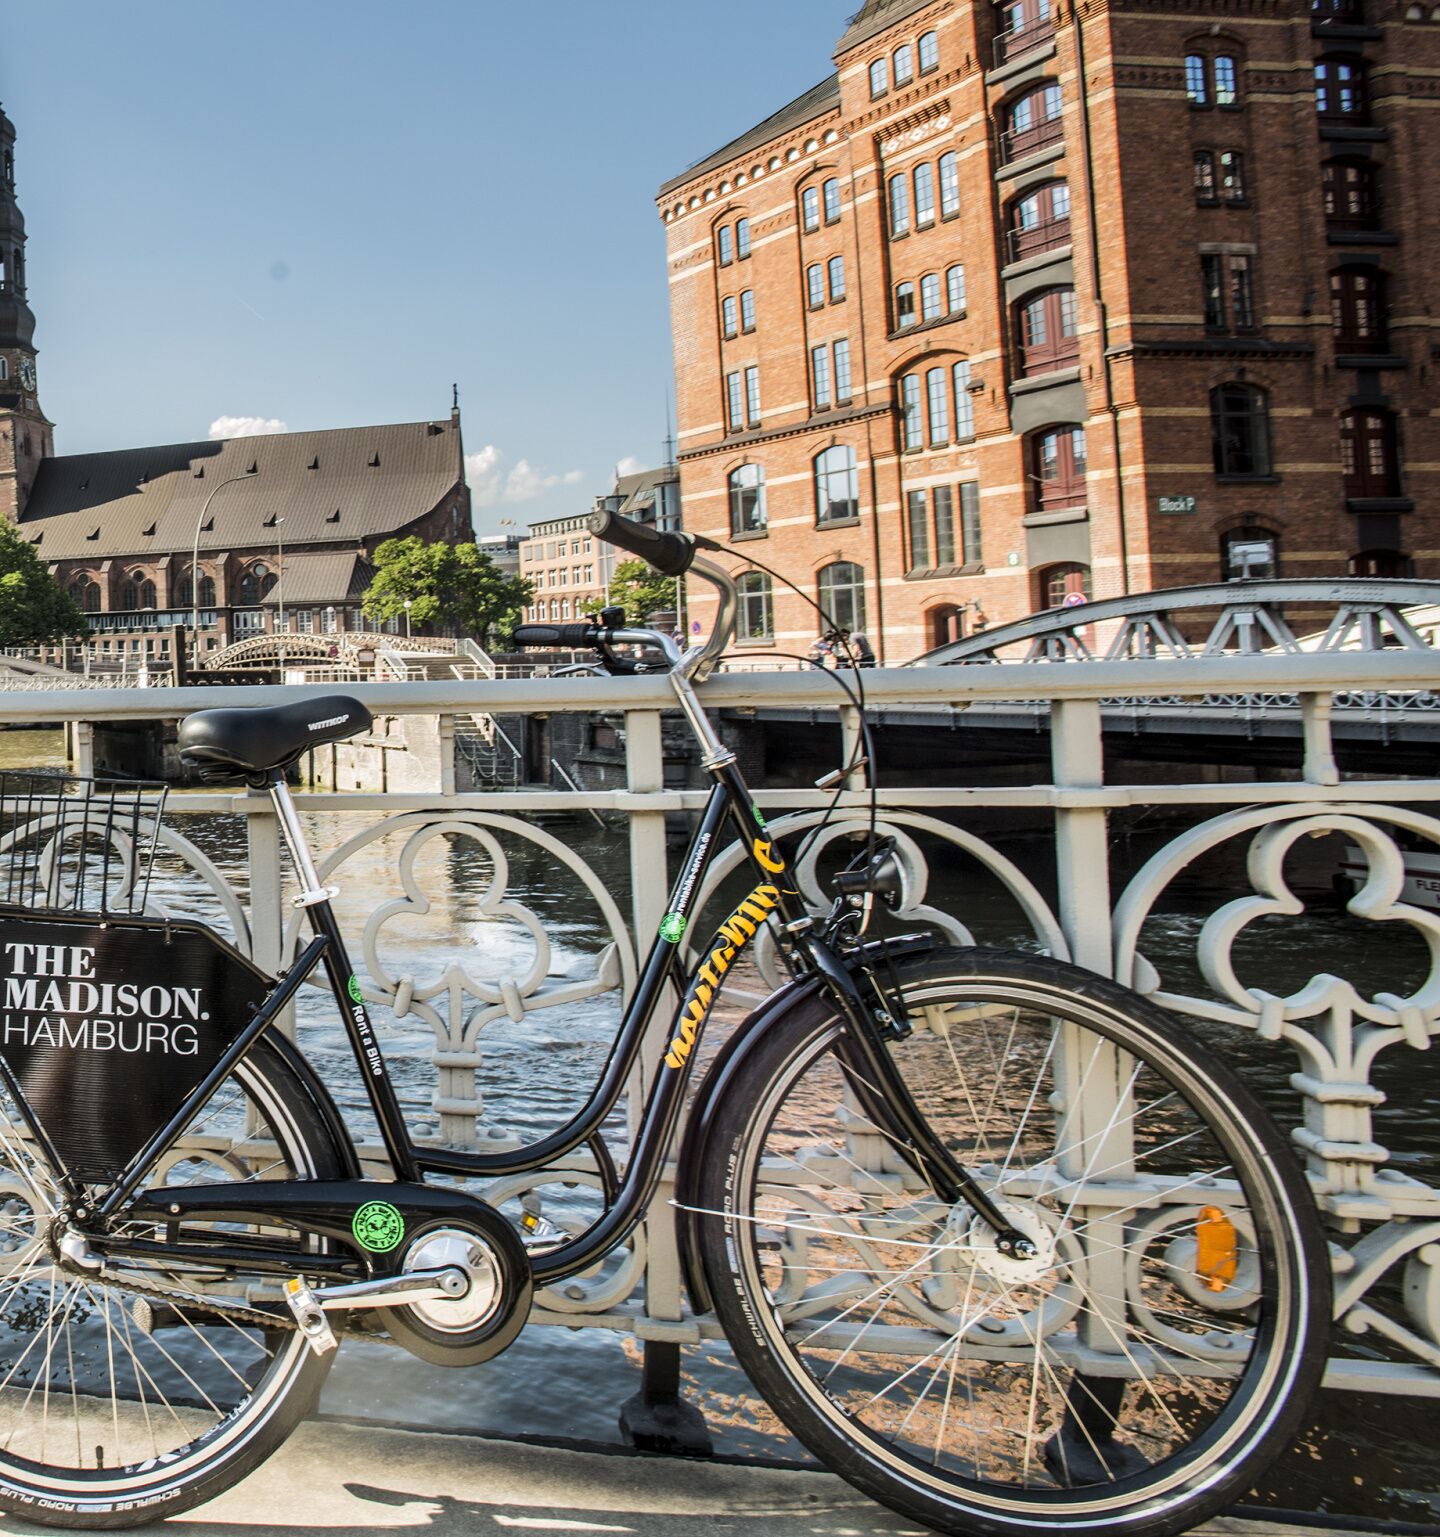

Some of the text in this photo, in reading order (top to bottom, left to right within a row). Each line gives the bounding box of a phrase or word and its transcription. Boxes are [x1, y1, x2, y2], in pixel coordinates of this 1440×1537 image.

[1158, 497, 1196, 512] Block P
[5, 943, 96, 979] THE
[2, 978, 210, 1021] MADISON.
[4, 1015, 199, 1055] HAMBURG
[352, 1005, 370, 1036] Rent
[363, 1037, 372, 1046] a
[366, 1047, 383, 1076] Bike
[725, 1153, 737, 1190] PLUS
[733, 1278, 767, 1346] SCHWALBE
[0, 1486, 34, 1504] PLUS
[37, 1498, 76, 1513] ROAD
[116, 1488, 182, 1512] SCHWALBE
